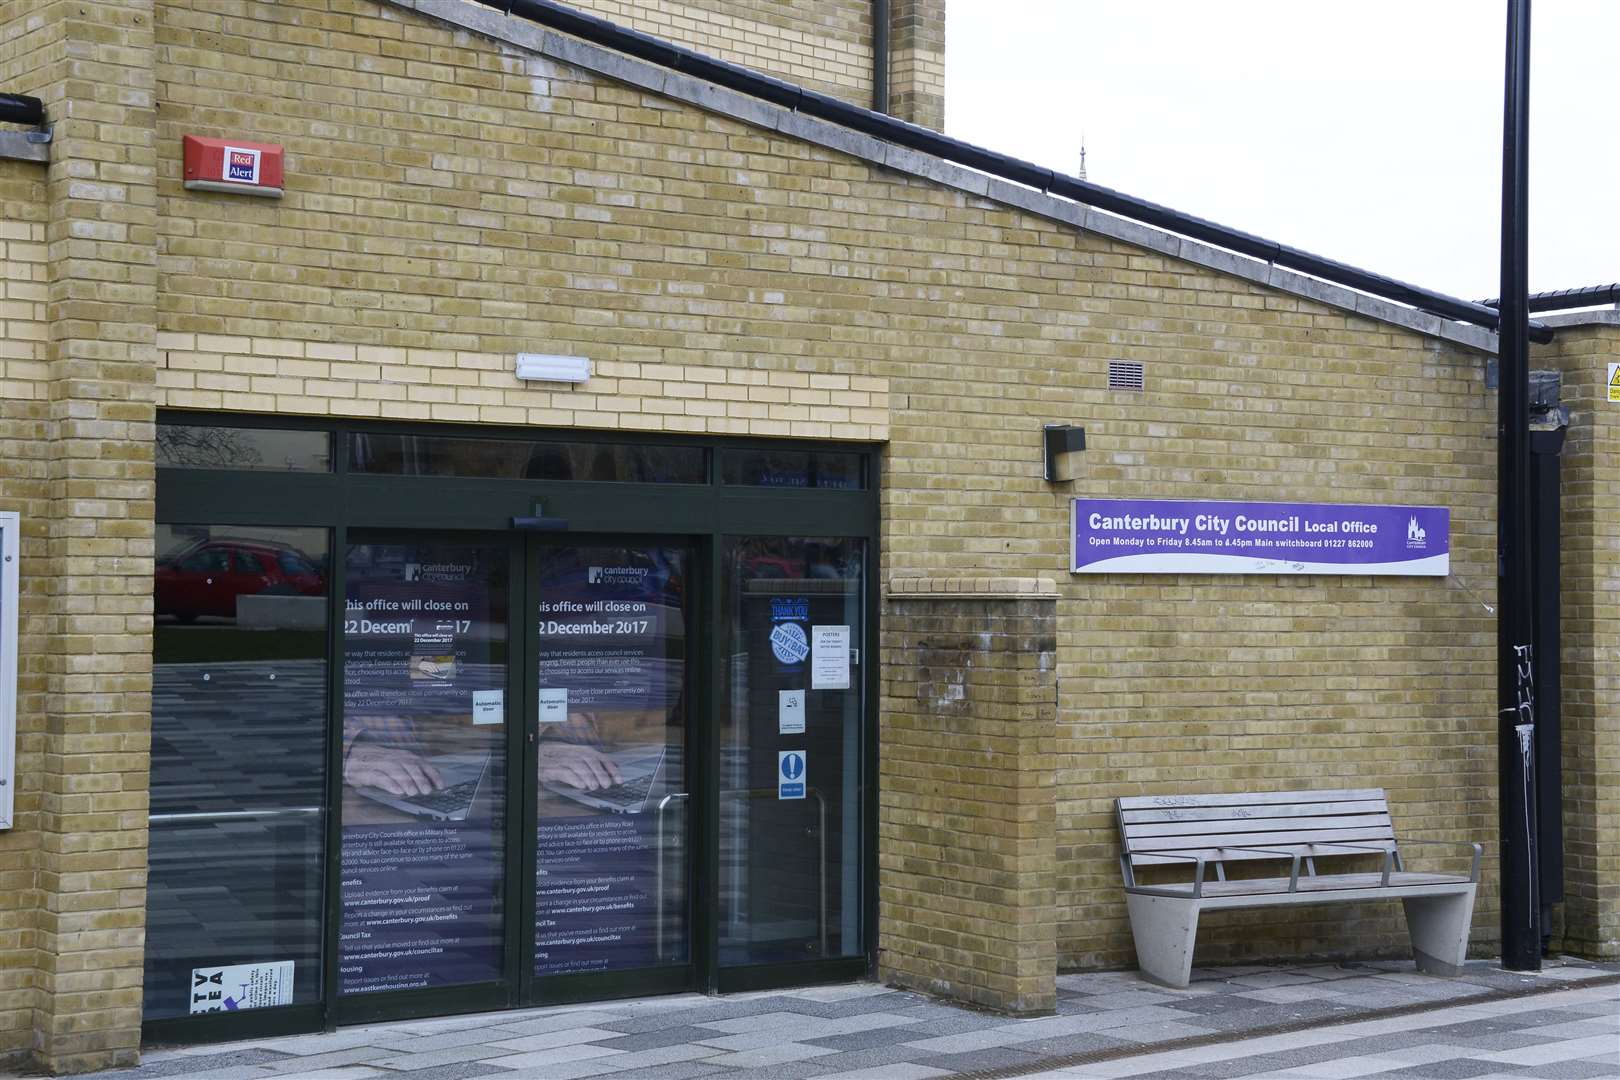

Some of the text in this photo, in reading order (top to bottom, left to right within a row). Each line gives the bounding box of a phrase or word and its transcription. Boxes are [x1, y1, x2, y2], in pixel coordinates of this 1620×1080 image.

[234, 155, 251, 164] Red
[230, 166, 252, 178] Alert
[1089, 513, 1378, 535] Canterbury City Council Local Office
[1089, 537, 1110, 546] Open
[1113, 537, 1144, 547] Monday
[1158, 538, 1182, 548] Friday
[1185, 538, 1212, 546] 8.45am
[1276, 539, 1322, 547] switchboard
[422, 563, 472, 574] canterbury
[604, 567, 648, 576] canterbury
[366, 599, 399, 610] office
[401, 600, 422, 610] will
[424, 600, 452, 610] close
[454, 602, 468, 610] on
[552, 601, 583, 612] office
[586, 601, 602, 611] will
[605, 601, 630, 611] close
[773, 606, 808, 616] THANK YOU
[548, 621, 614, 634] December
[616, 621, 648, 633] 2017
[773, 630, 790, 646] BUY
[790, 641, 808, 657] BAY
[344, 895, 430, 906] www.canterbury.gov.uk/proof
[552, 903, 634, 914] www.canterbury.gov.uk/benefits
[366, 913, 458, 926] www.canterbury.gov.uk/benefits
[344, 947, 443, 960] www.canterbury.gov.uk/counciltax
